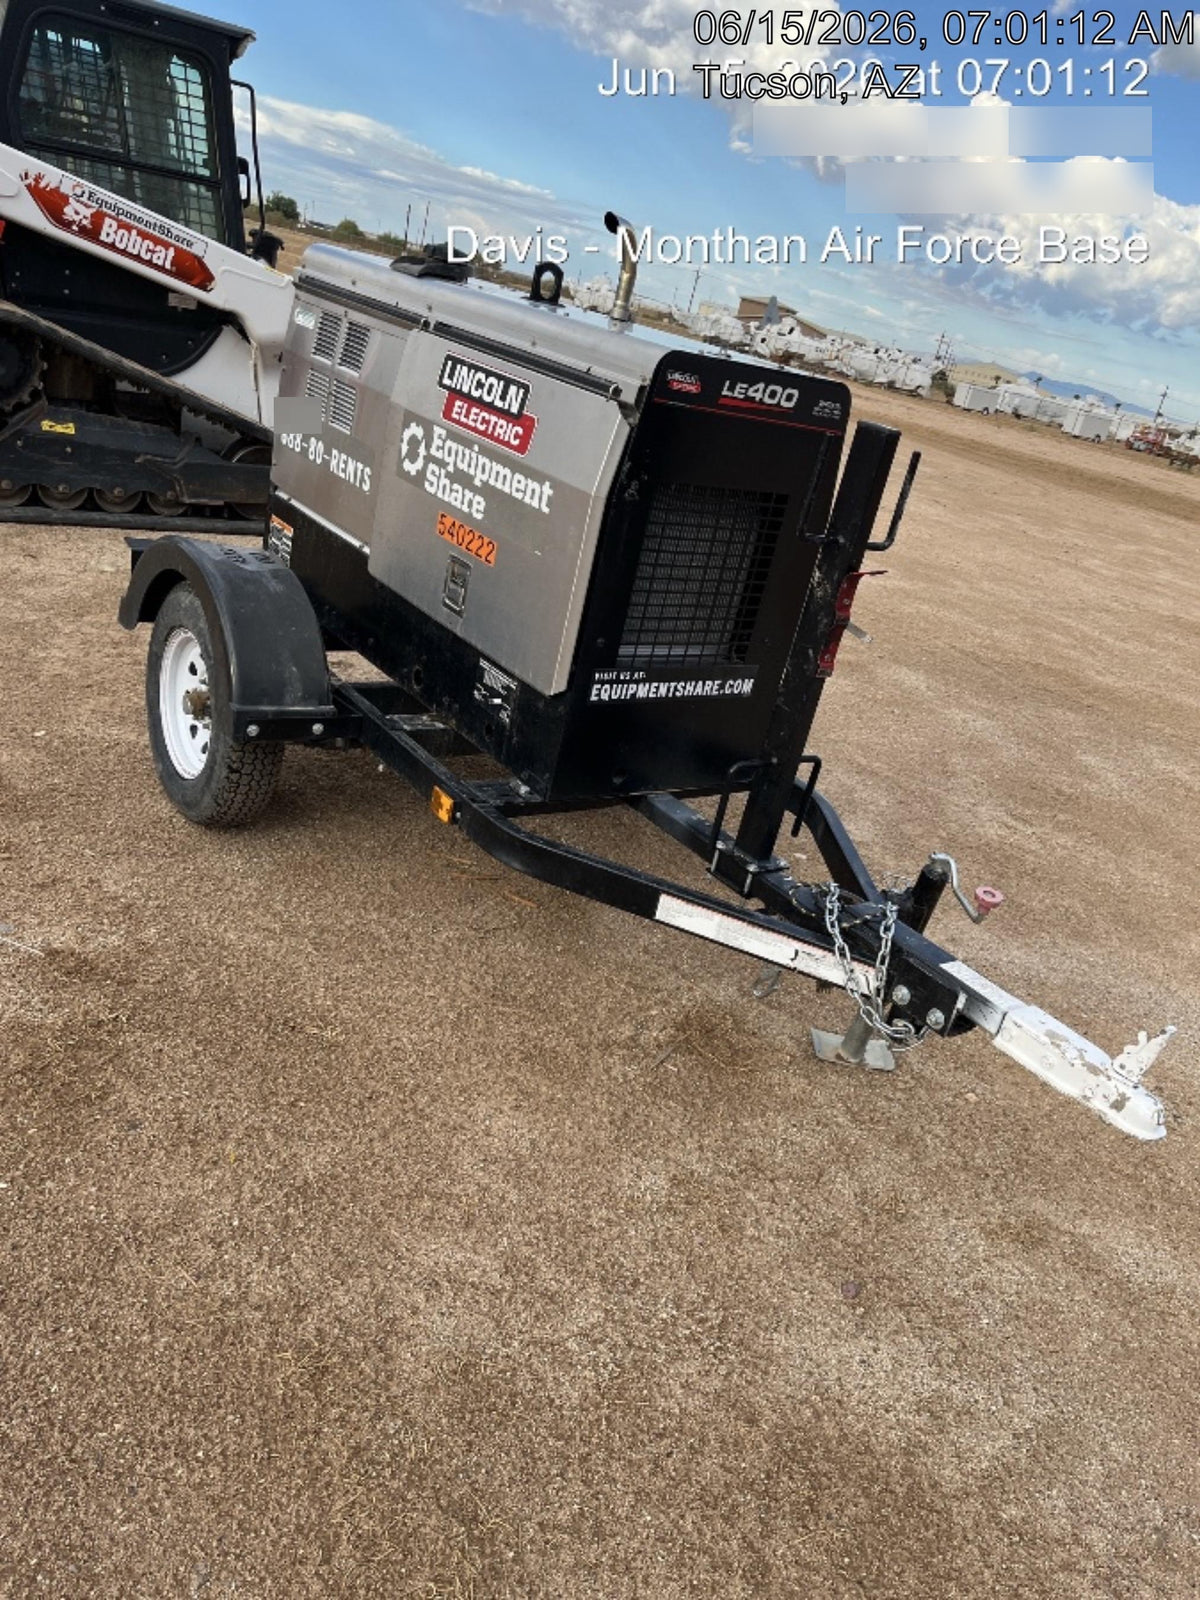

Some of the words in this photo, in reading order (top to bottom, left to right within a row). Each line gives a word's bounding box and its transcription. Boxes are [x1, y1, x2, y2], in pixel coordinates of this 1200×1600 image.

[99, 216, 176, 270] Bobcat
[442, 360, 525, 414] LINCOLN
[721, 380, 799, 408] LE400
[451, 400, 523, 445] ELECTRIC
[424, 462, 486, 520] Share
[430, 424, 554, 514] Equipment
[438, 513, 496, 564] 540222
[590, 678, 755, 701] EQUIPMENTSHARE.COM
